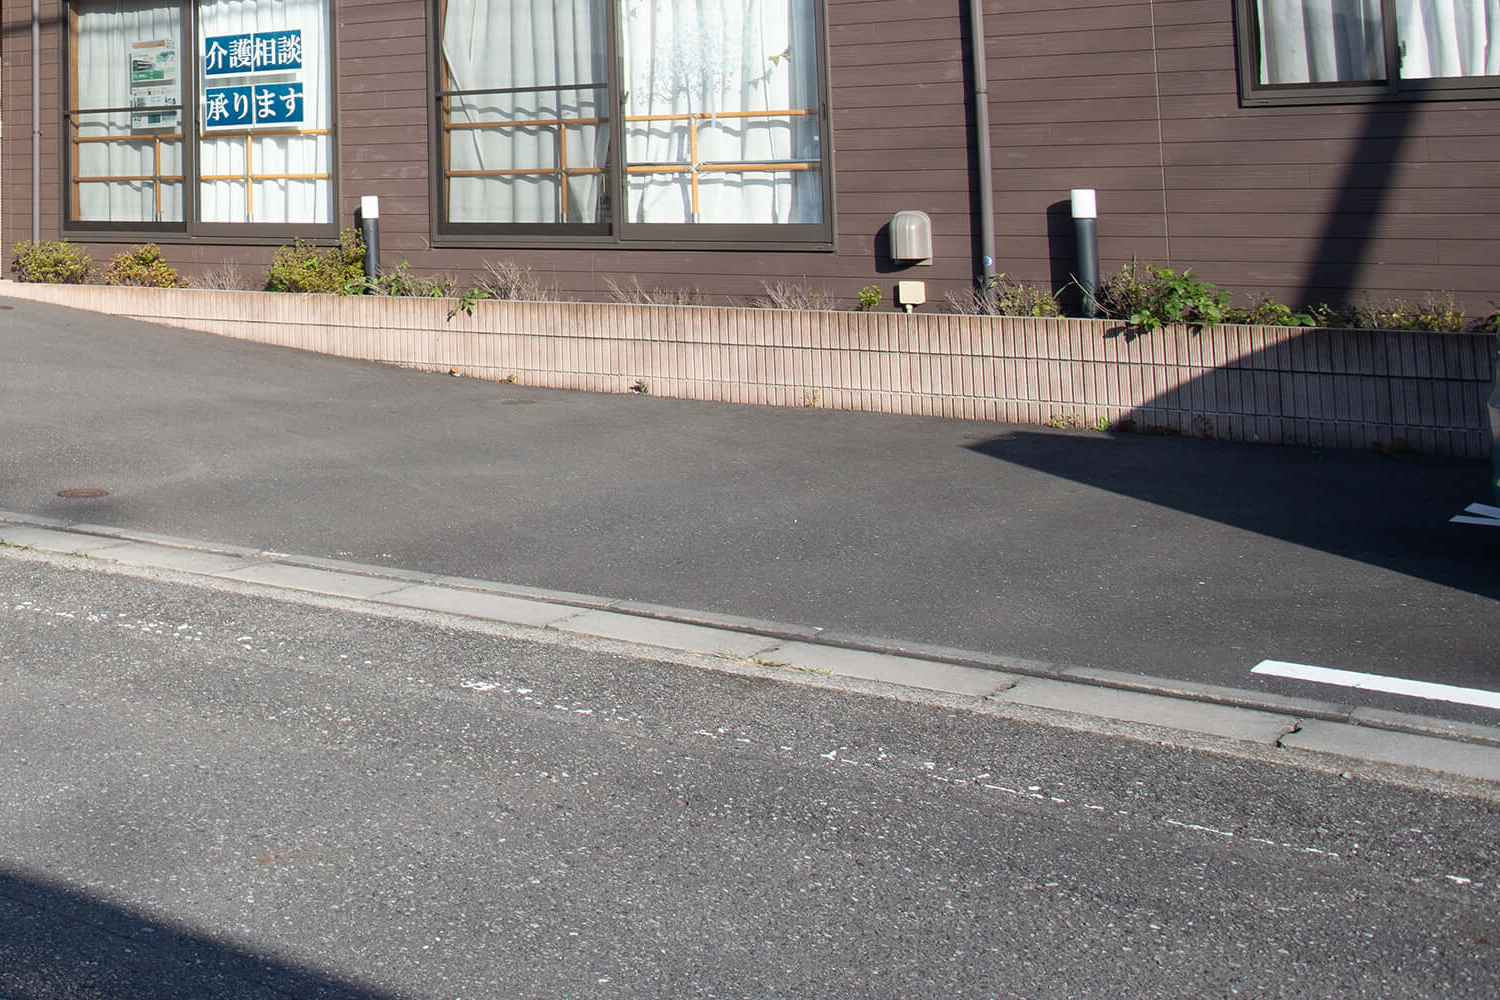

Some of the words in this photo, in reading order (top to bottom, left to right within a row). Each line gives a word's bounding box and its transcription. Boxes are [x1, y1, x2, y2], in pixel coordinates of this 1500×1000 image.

[206, 34, 302, 70] 介護相談
[206, 88, 304, 121] 承ります
